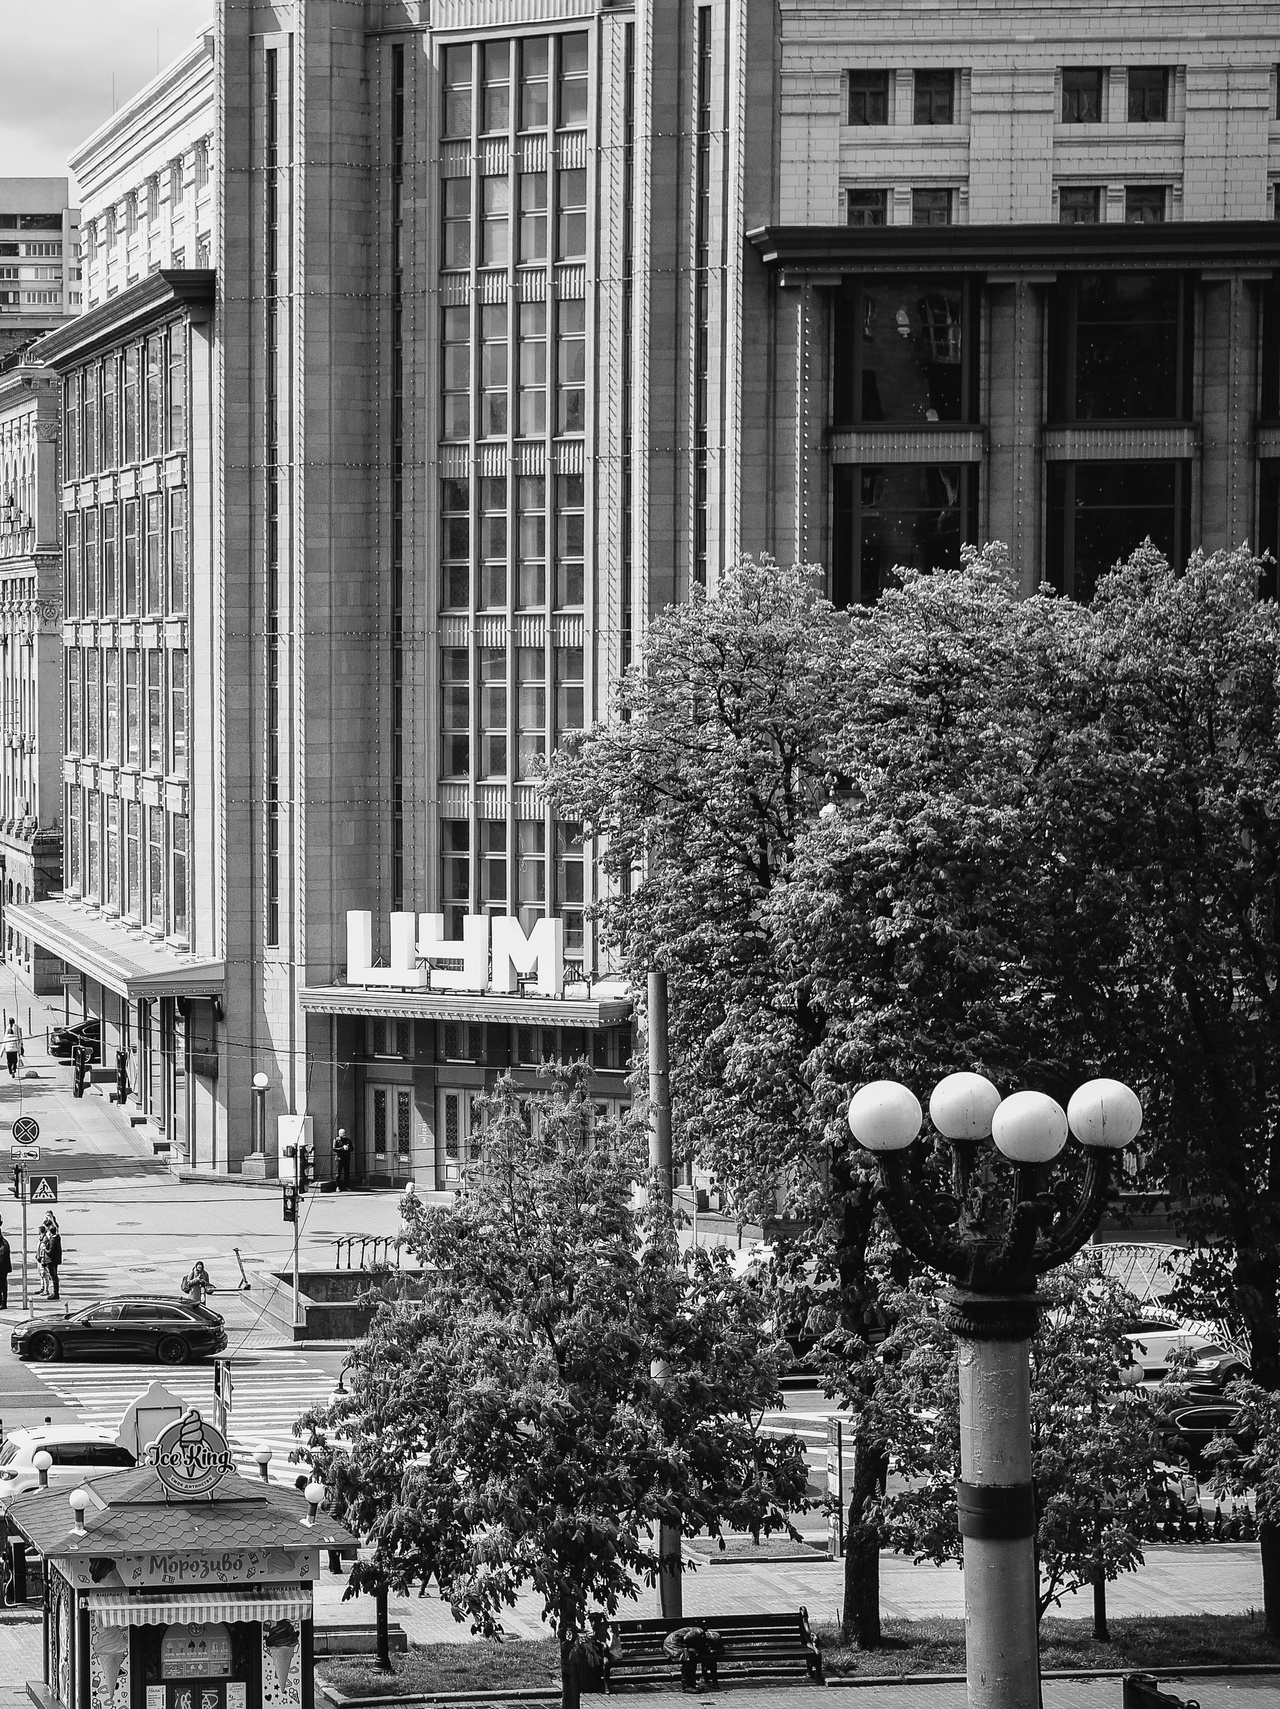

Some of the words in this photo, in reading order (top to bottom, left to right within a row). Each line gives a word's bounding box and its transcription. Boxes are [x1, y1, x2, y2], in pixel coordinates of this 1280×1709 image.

[346, 909, 563, 999] ЦУМ
[148, 1443, 181, 1467] Ice
[183, 1444, 236, 1474] King
[149, 1553, 243, 1579] Морозиво
